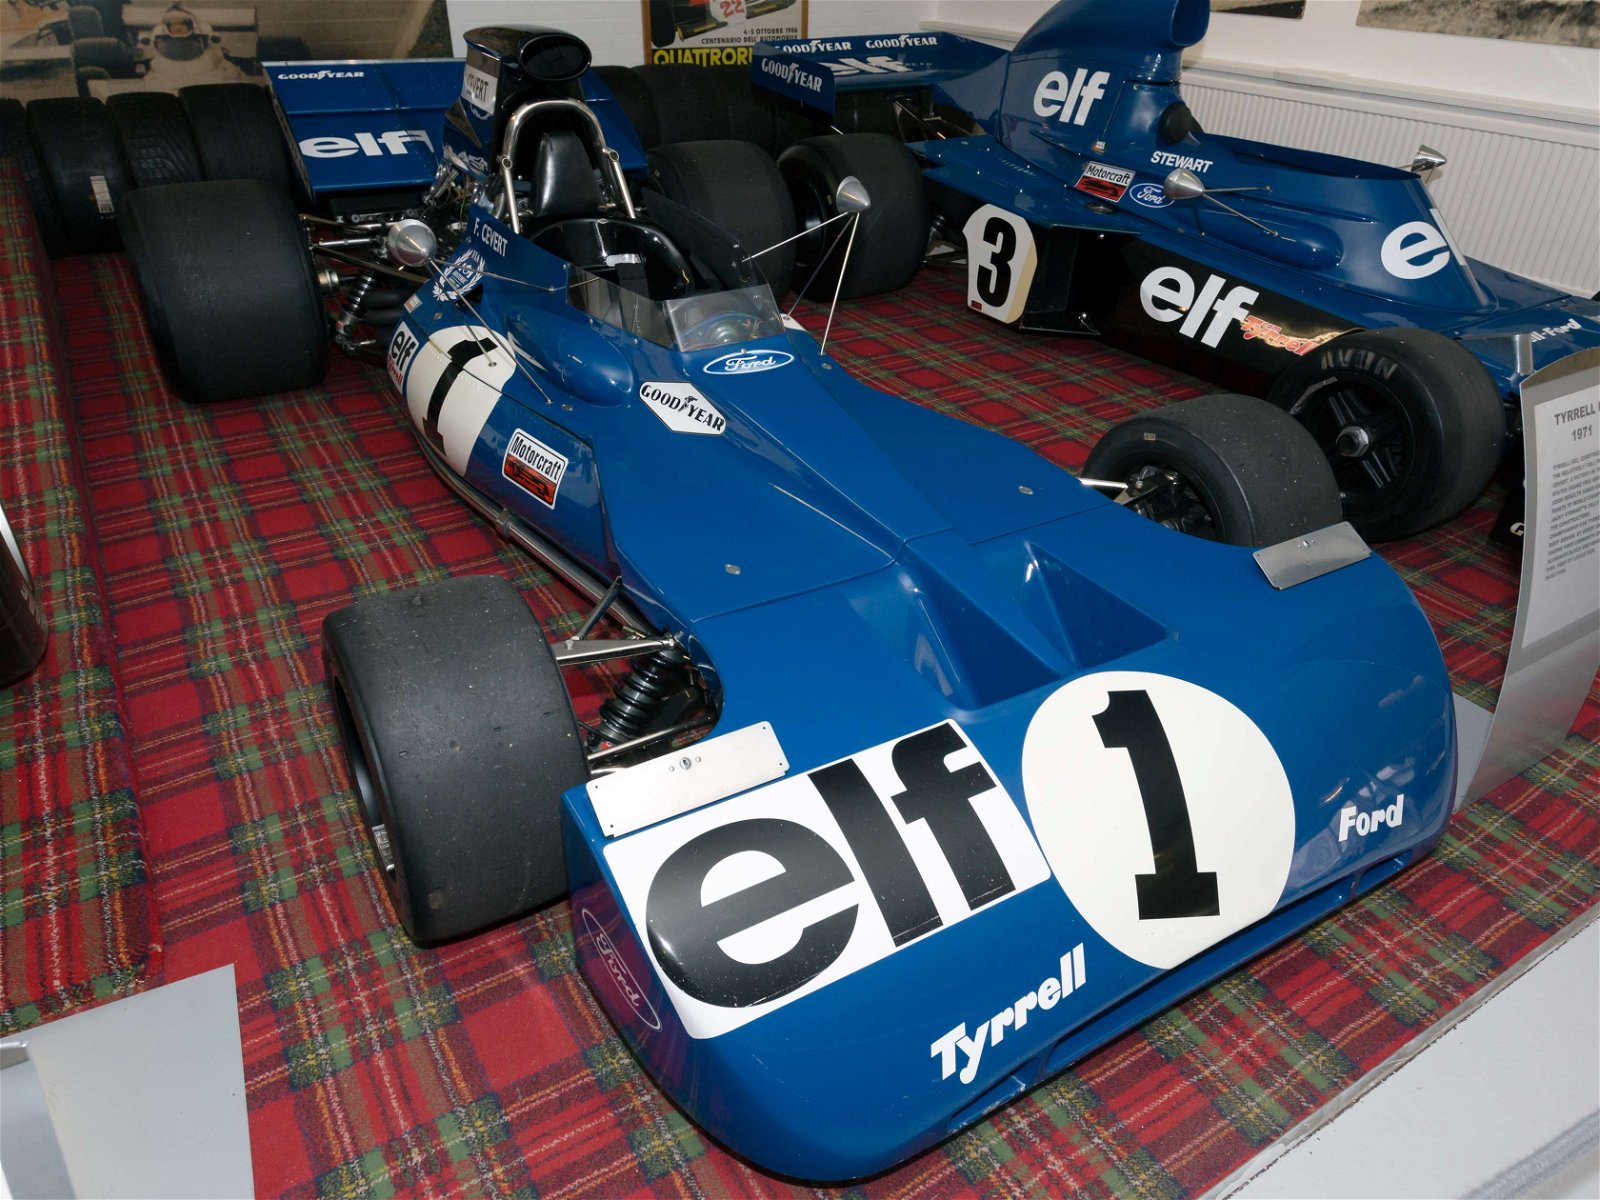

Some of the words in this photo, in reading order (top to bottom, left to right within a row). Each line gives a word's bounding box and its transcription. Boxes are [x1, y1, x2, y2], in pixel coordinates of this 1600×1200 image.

[756, 27, 783, 35] OTTOBRE
[776, 40, 853, 54] OODYEAR
[865, 34, 938, 49] GOODYEAR
[278, 70, 364, 80] GOODYEAR
[761, 57, 823, 93] GOODYEAR
[1033, 68, 1110, 126] elf
[299, 130, 434, 158] elf
[1151, 151, 1214, 173] STEWART
[1086, 164, 1132, 186] Motorcraft
[1136, 186, 1166, 205] Ford
[481, 224, 509, 257] CEVERT
[1380, 221, 1450, 279] e
[976, 216, 1017, 308] 3
[1140, 266, 1260, 349] elf
[391, 331, 417, 371] elf
[724, 355, 776, 372] Ford
[423, 336, 498, 457] 1
[641, 384, 725, 432] GOODYEAR
[1554, 403, 1596, 426] TYRRELL
[1572, 425, 1592, 441] 1971
[510, 436, 562, 481] Motorcraft
[1092, 690, 1219, 920] 1
[1338, 794, 1405, 843] Ford
[647, 722, 1016, 1008] elf
[597, 933, 639, 1007] Ford
[930, 942, 1087, 1084] Tyrrell
